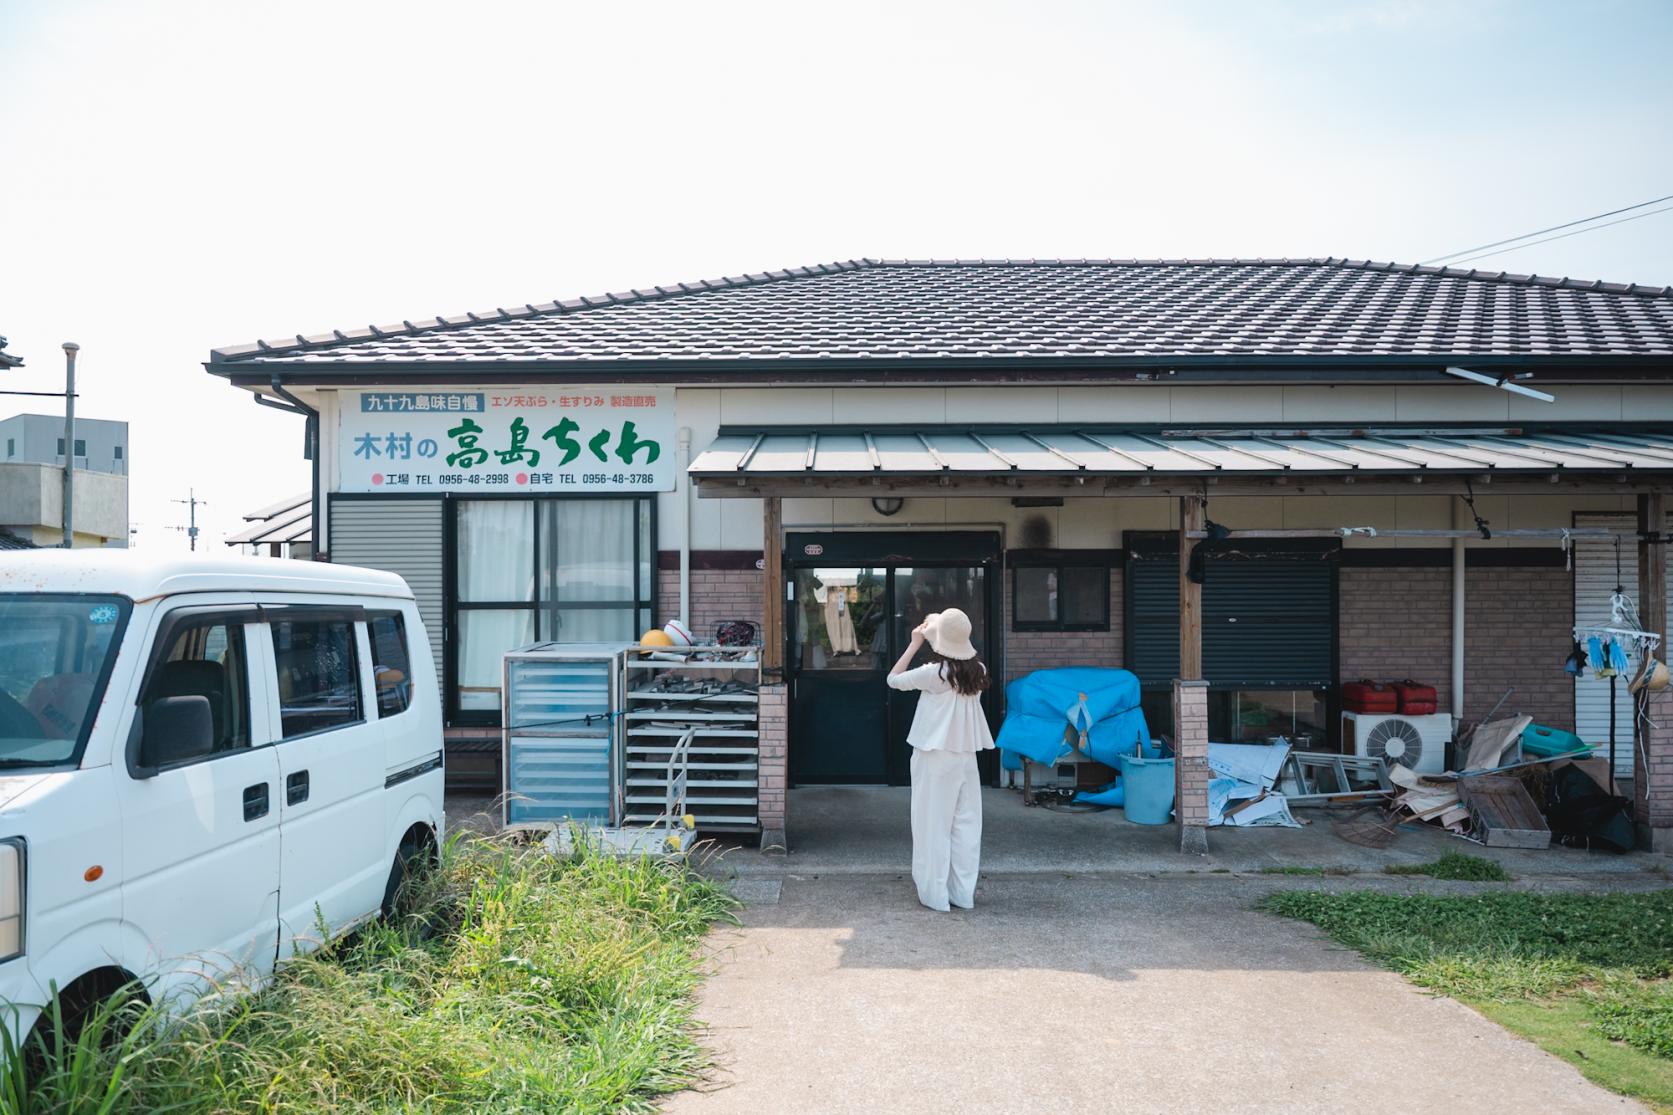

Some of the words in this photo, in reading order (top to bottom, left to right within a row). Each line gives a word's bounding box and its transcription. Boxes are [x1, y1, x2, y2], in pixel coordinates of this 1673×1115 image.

[368, 395, 478, 411] 九十九島味自慢
[353, 431, 438, 460] 木村の
[446, 416, 661, 469] 高島ちくわ
[385, 474, 409, 485] 工場
[416, 474, 432, 485] TEL
[439, 474, 509, 485] 0956-48-2998
[530, 473, 553, 485] 自宅
[560, 473, 576, 484] TEL
[582, 473, 654, 484] 0956-48-3786
